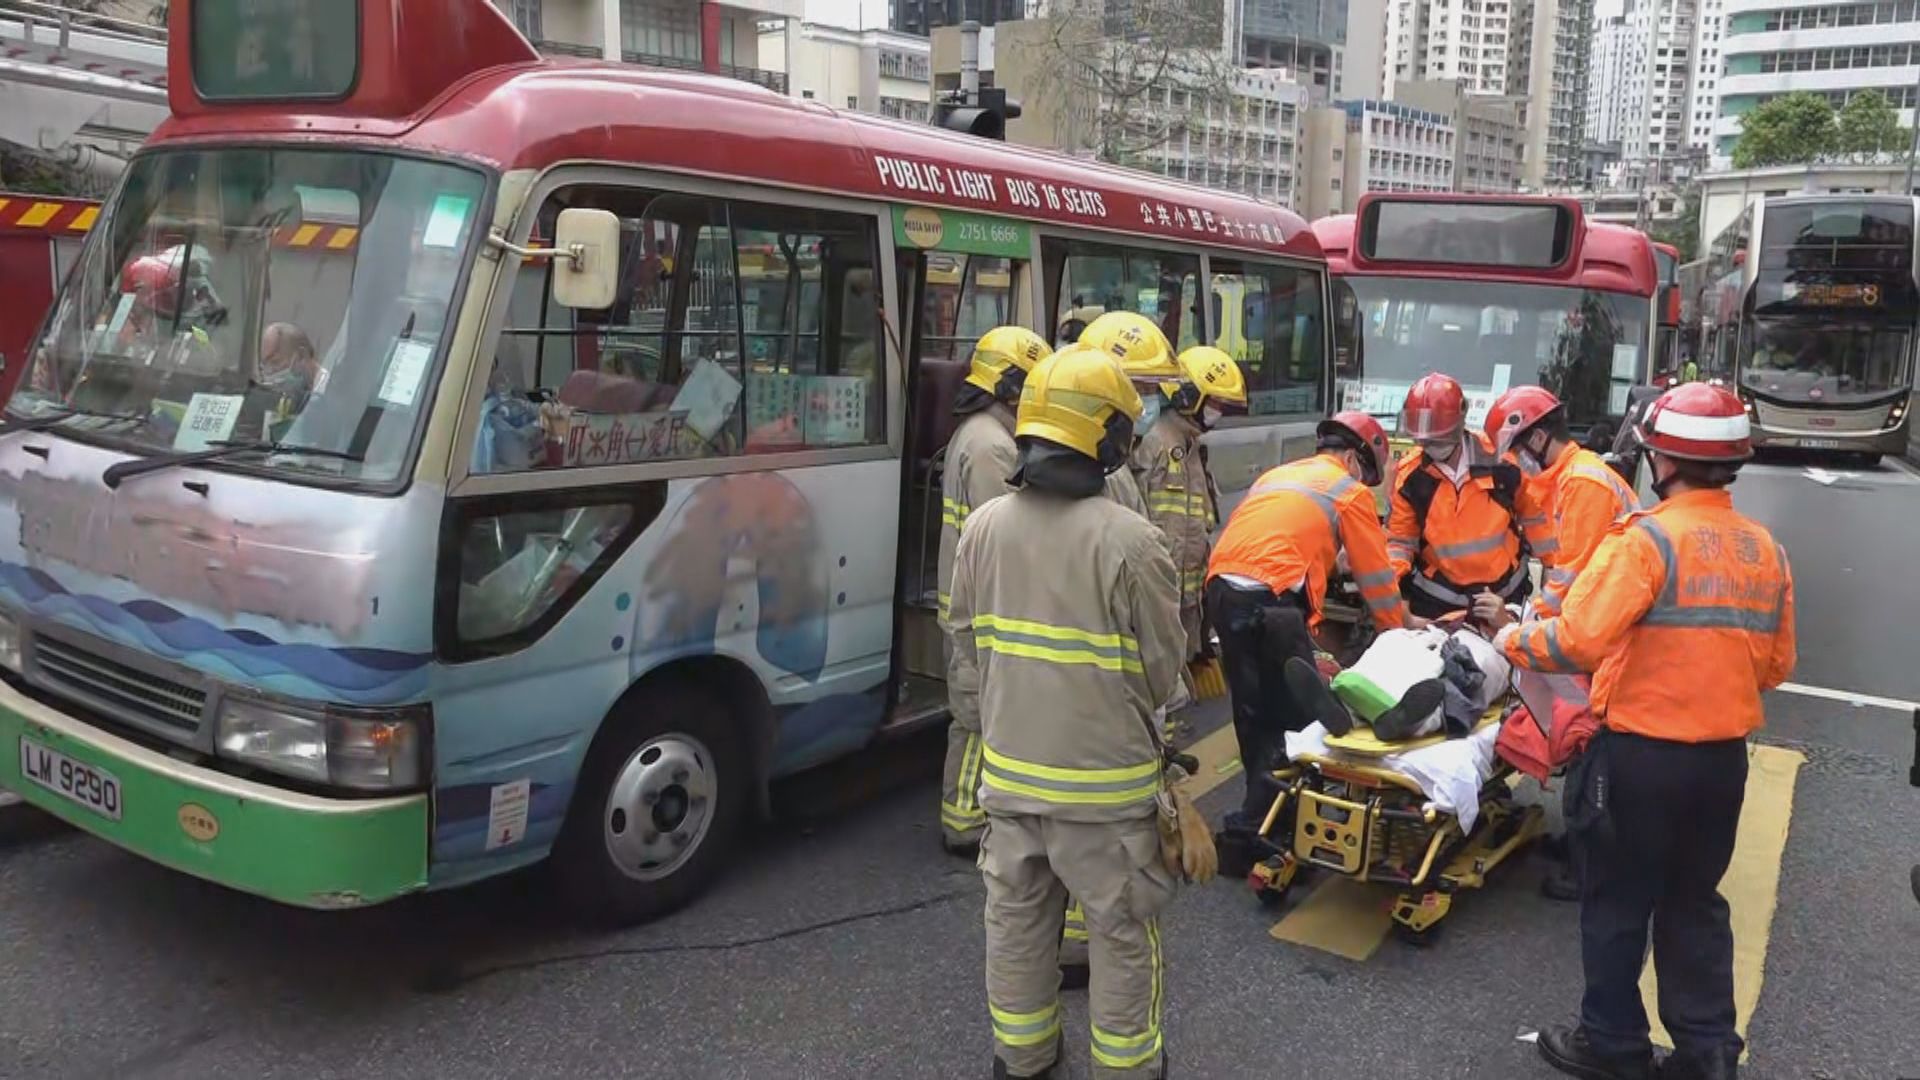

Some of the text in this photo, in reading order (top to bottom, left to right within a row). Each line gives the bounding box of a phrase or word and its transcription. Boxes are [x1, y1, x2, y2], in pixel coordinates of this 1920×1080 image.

[874, 155, 1107, 217] PUBLIC LIGHT BUS 16 SEATS
[959, 222, 1019, 242] 2751 6666
[26, 745, 117, 813] LM 9290
